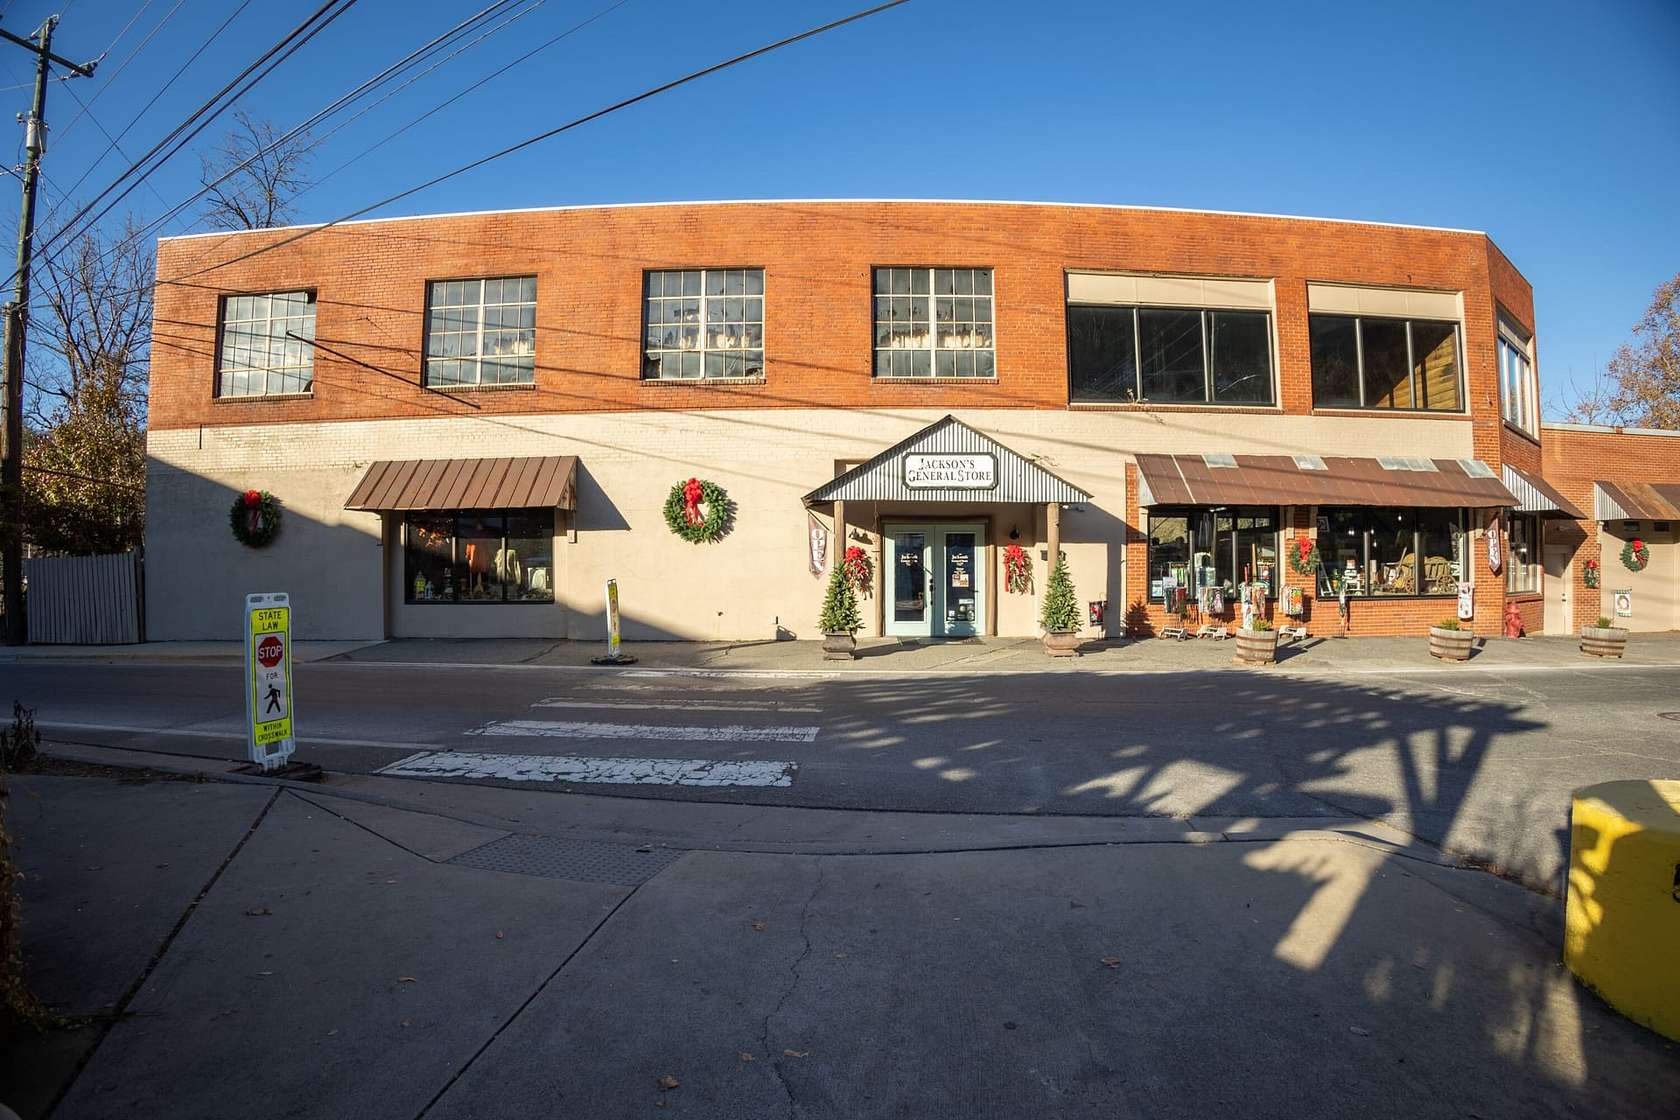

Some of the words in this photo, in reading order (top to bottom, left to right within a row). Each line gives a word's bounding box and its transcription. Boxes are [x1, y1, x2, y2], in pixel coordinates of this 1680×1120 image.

[918, 458, 975, 470] JACKSON'S
[908, 470, 956, 482] GENERAL
[957, 470, 992, 482] STORE
[258, 610, 282, 621] STATE
[262, 620, 279, 631] LAW
[258, 645, 282, 659] STOP
[265, 671, 279, 681] FOR
[263, 722, 282, 732] WITHIN
[258, 730, 287, 742] CROSSWALK
